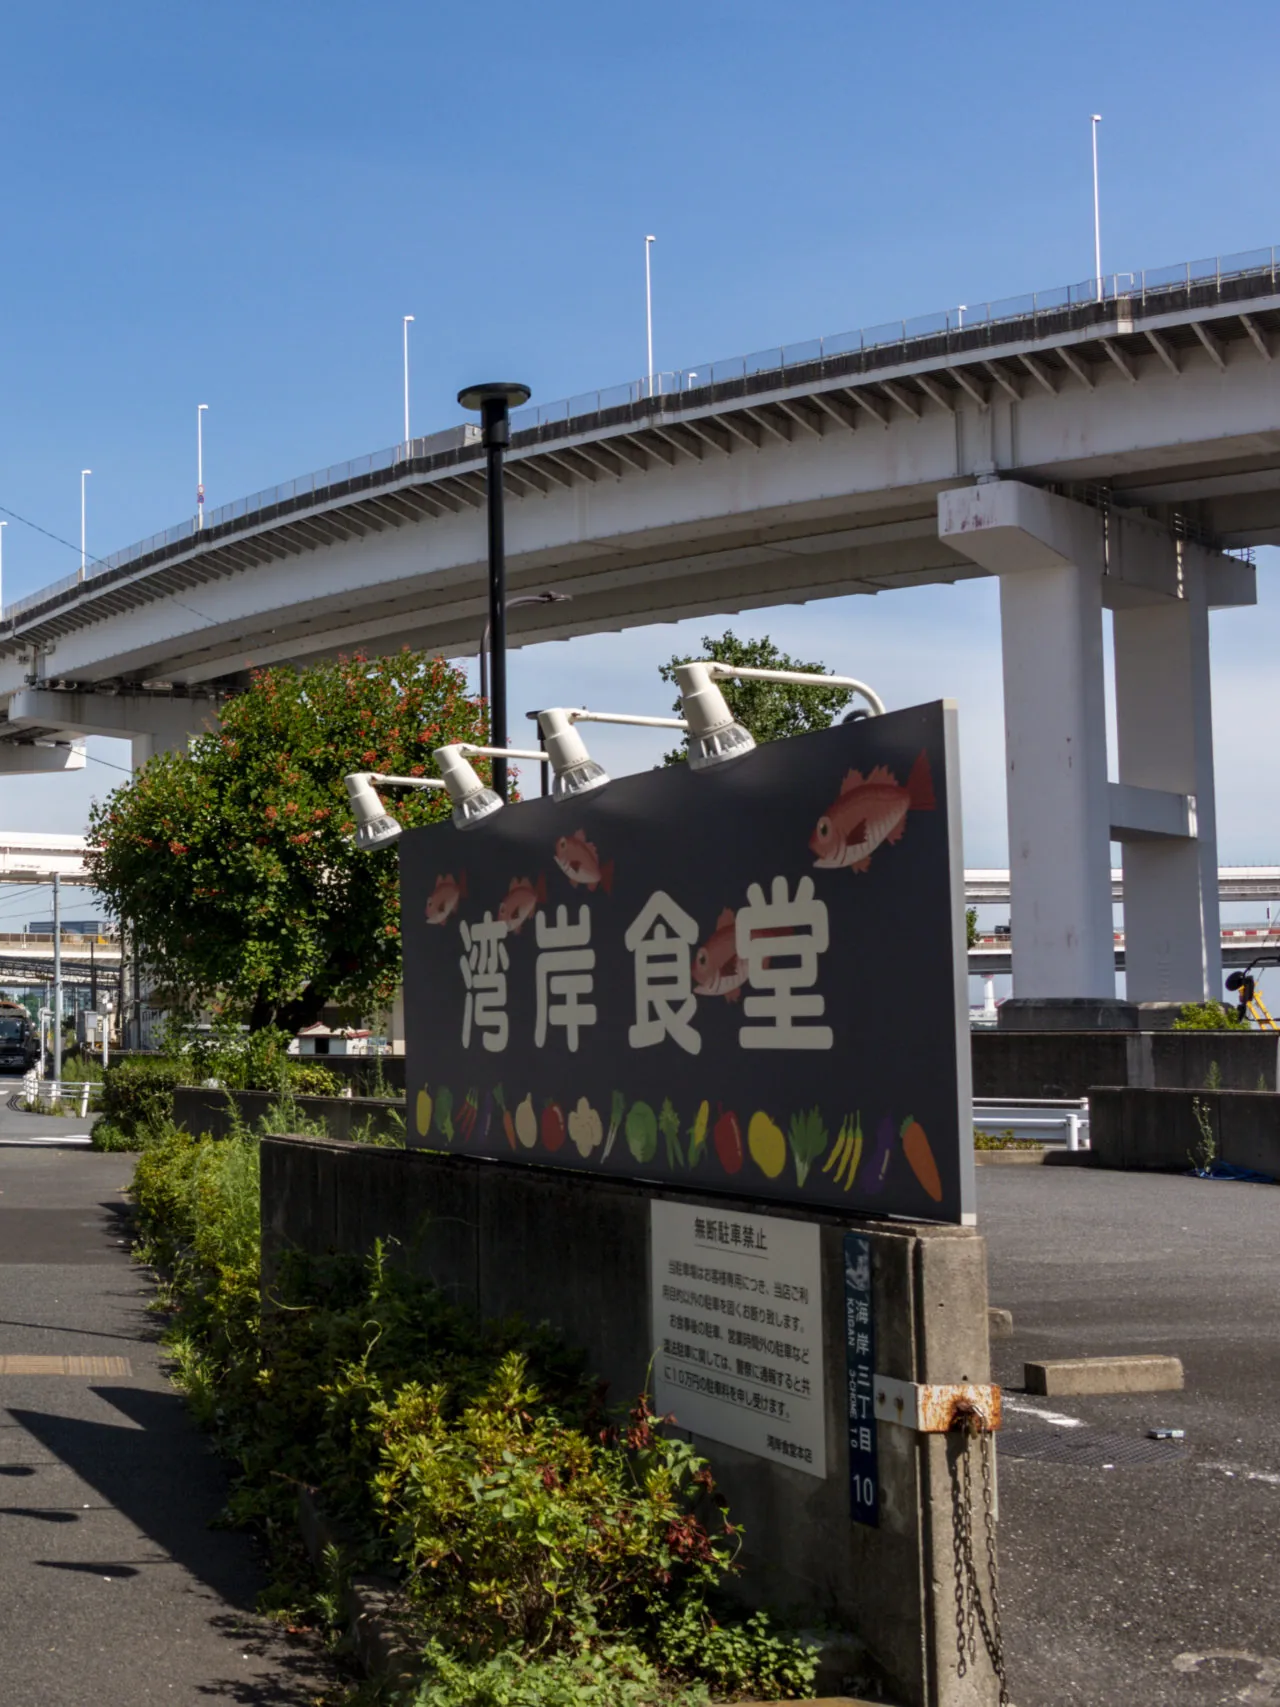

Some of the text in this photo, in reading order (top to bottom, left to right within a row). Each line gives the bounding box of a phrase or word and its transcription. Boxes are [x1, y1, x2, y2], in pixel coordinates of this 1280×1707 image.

[459, 875, 834, 1056] 湾岸食堂
[694, 1216, 768, 1250] 無断駐車禁止
[847, 1298, 856, 1346] KAIGAN
[853, 1474, 874, 1507] 10
